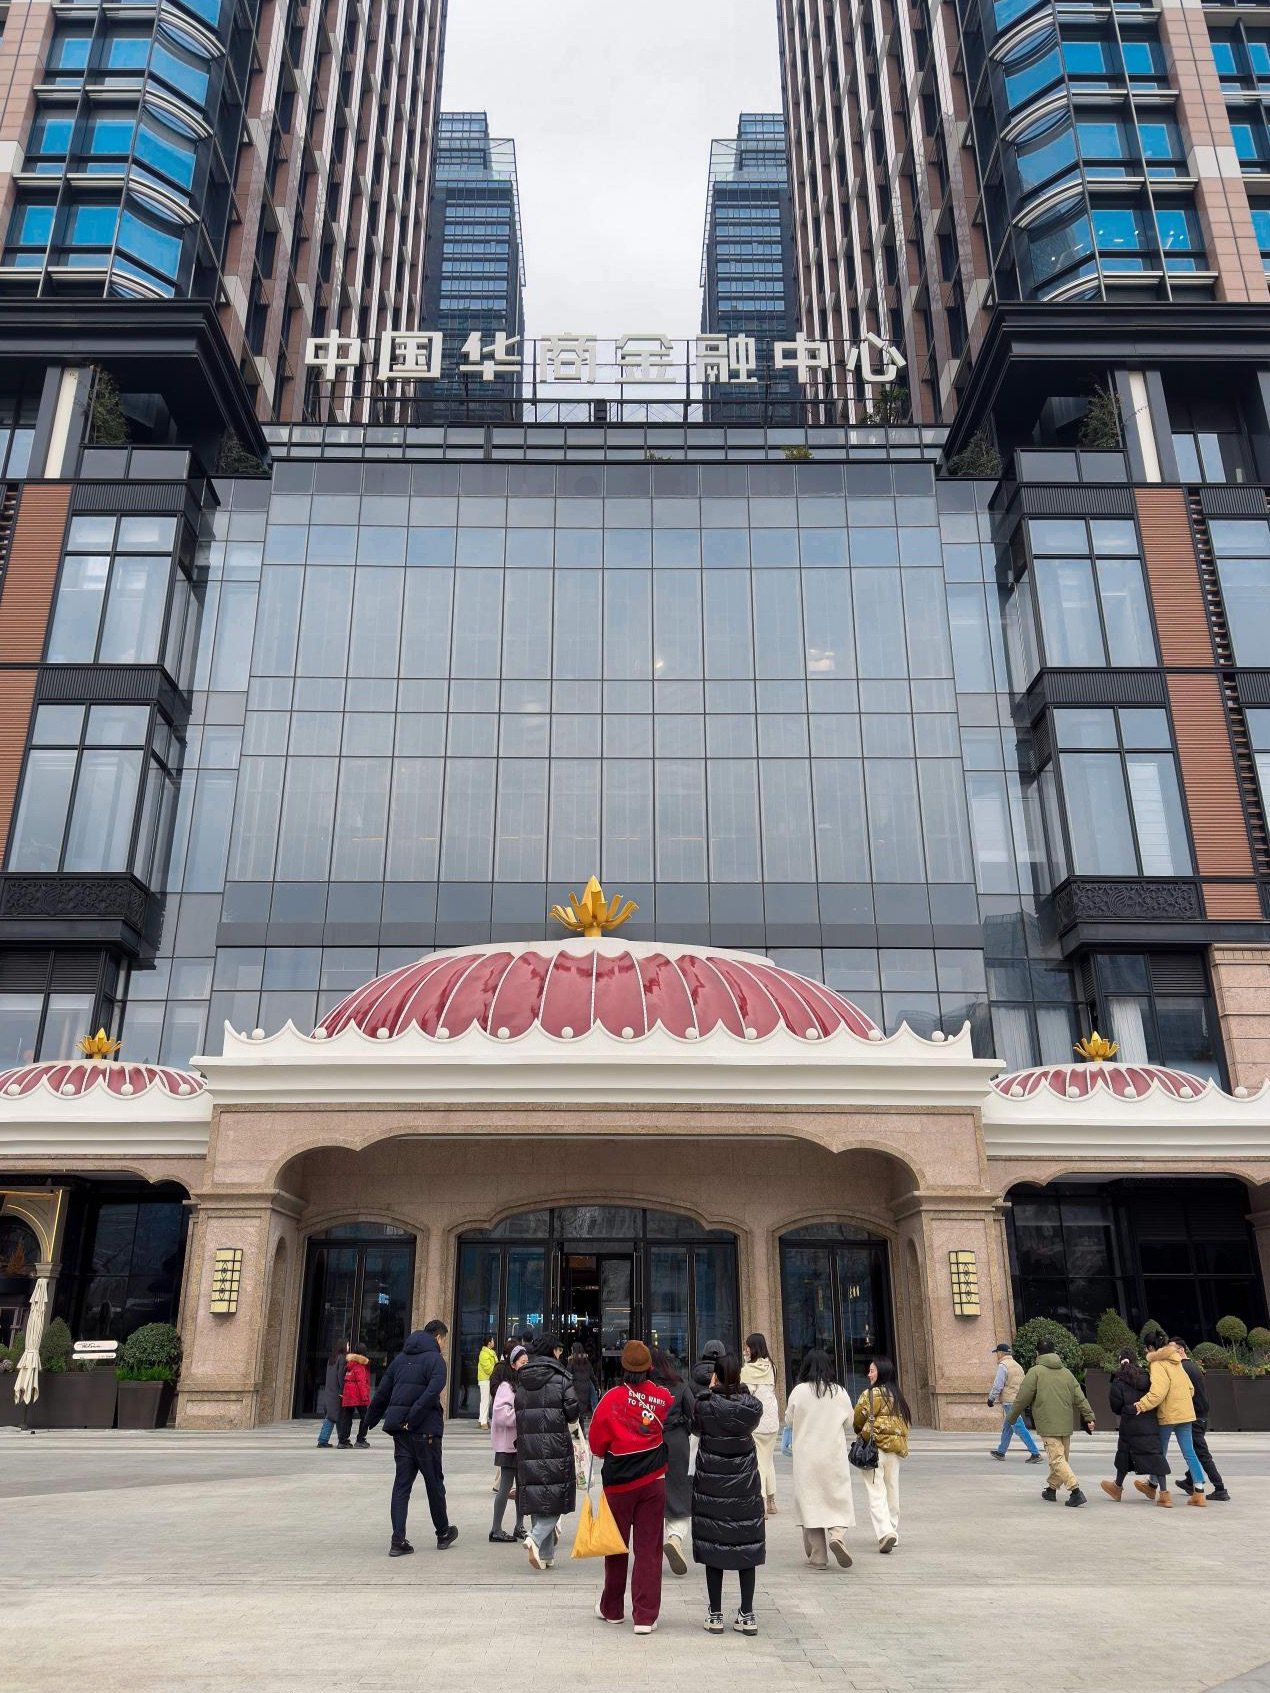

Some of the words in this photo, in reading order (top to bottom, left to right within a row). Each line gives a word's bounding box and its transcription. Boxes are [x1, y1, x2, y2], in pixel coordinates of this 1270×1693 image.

[304, 329, 907, 383] 中国华商金融中心
[628, 1398, 637, 1406] TO
[648, 1396, 666, 1406] WANTS
